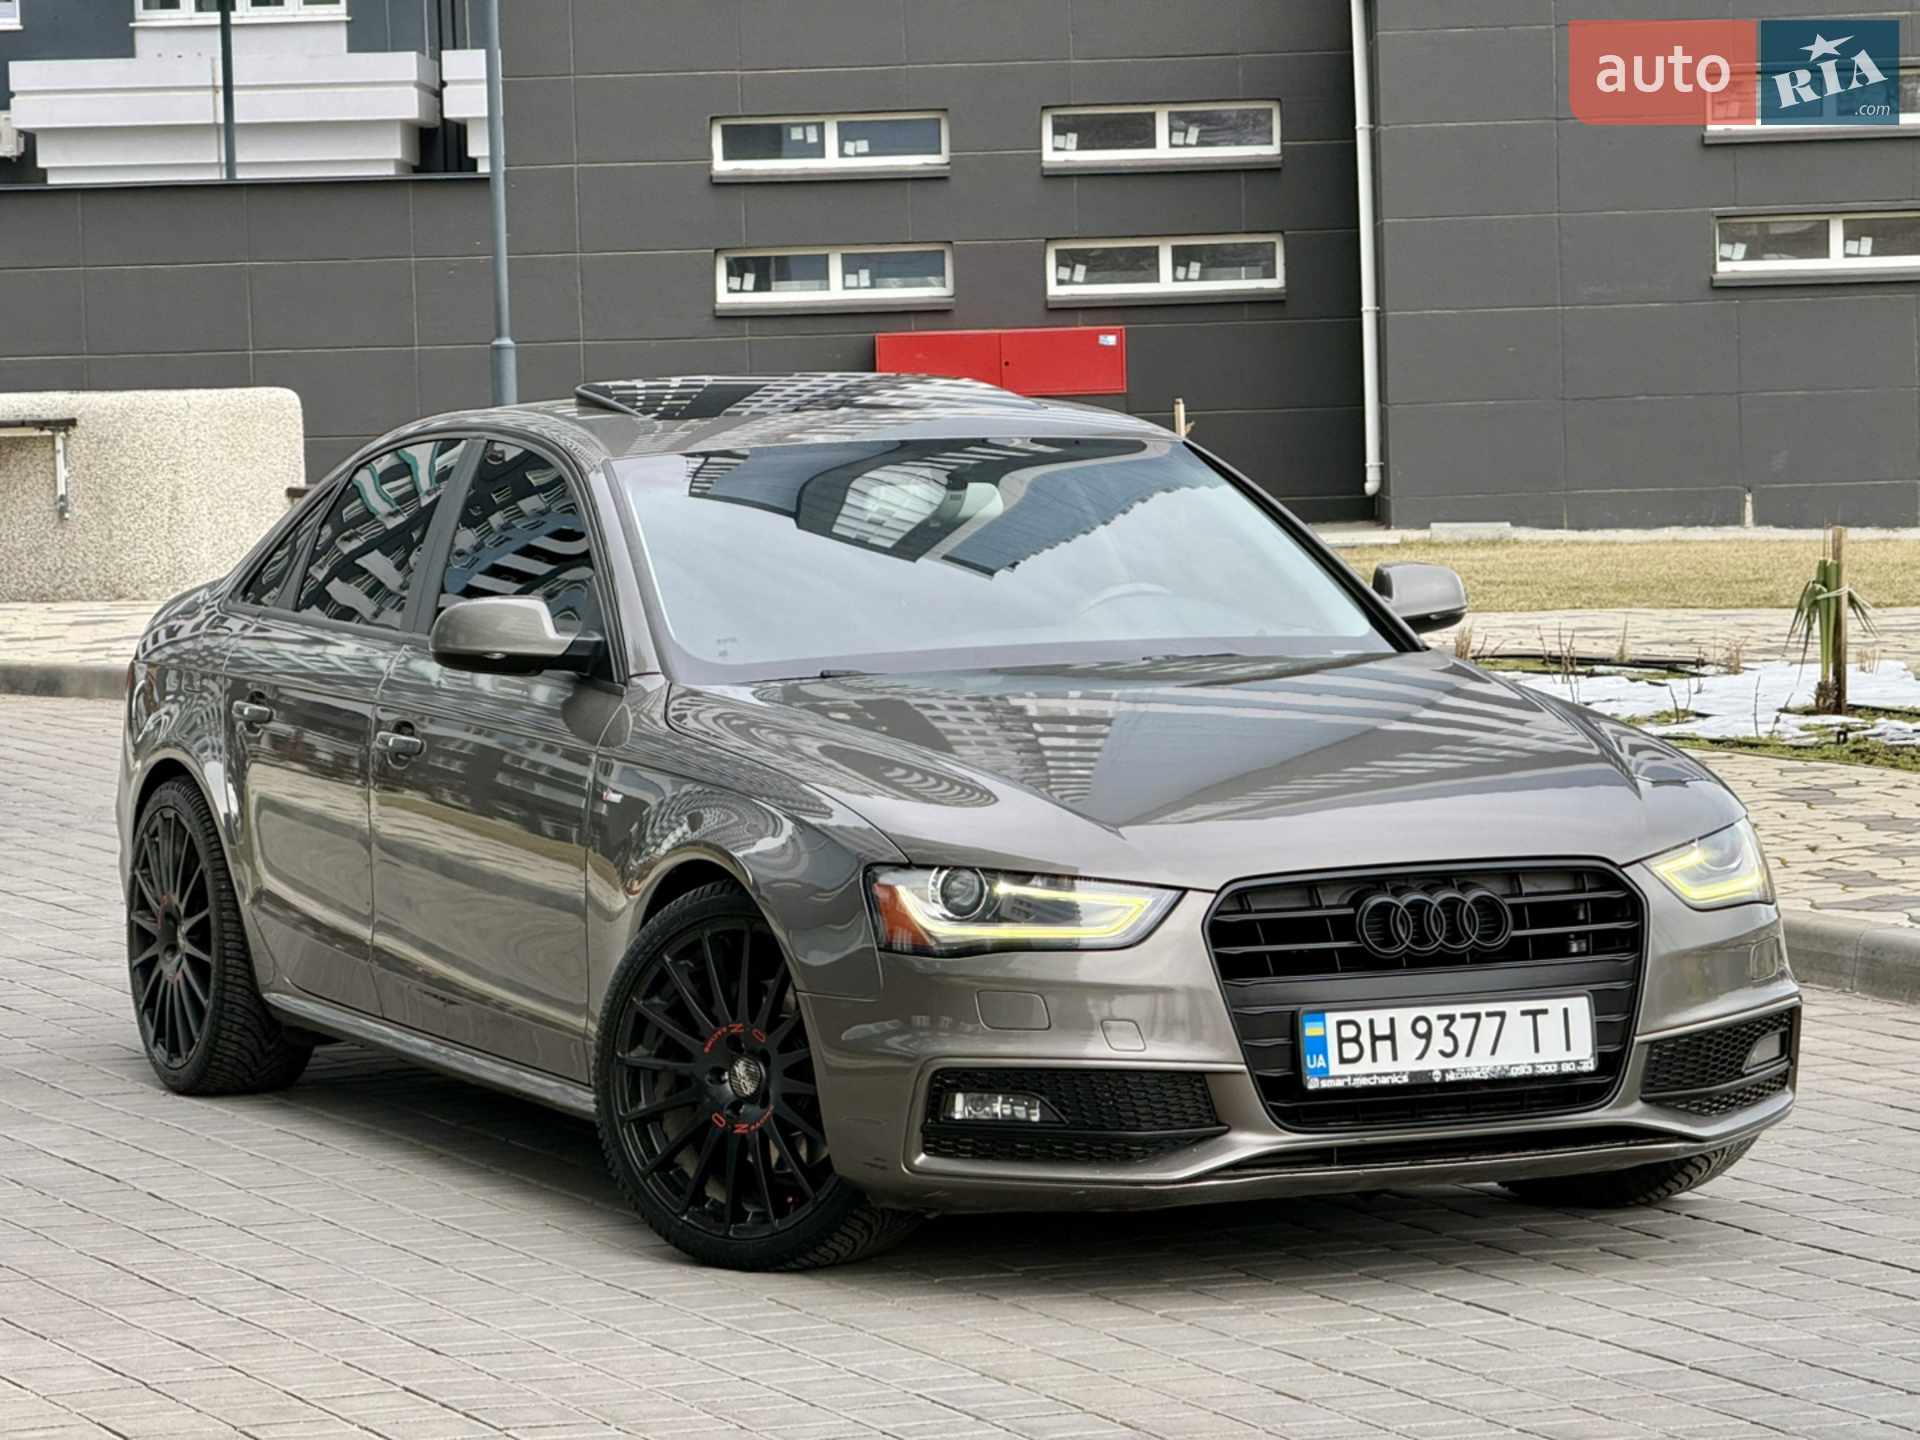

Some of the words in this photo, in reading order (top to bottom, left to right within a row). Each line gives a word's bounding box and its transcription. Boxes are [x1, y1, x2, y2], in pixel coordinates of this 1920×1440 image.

[1336, 1016, 1398, 1065] BH
[1411, 1010, 1507, 1061] 9377
[1306, 1053, 1327, 1069] UA
